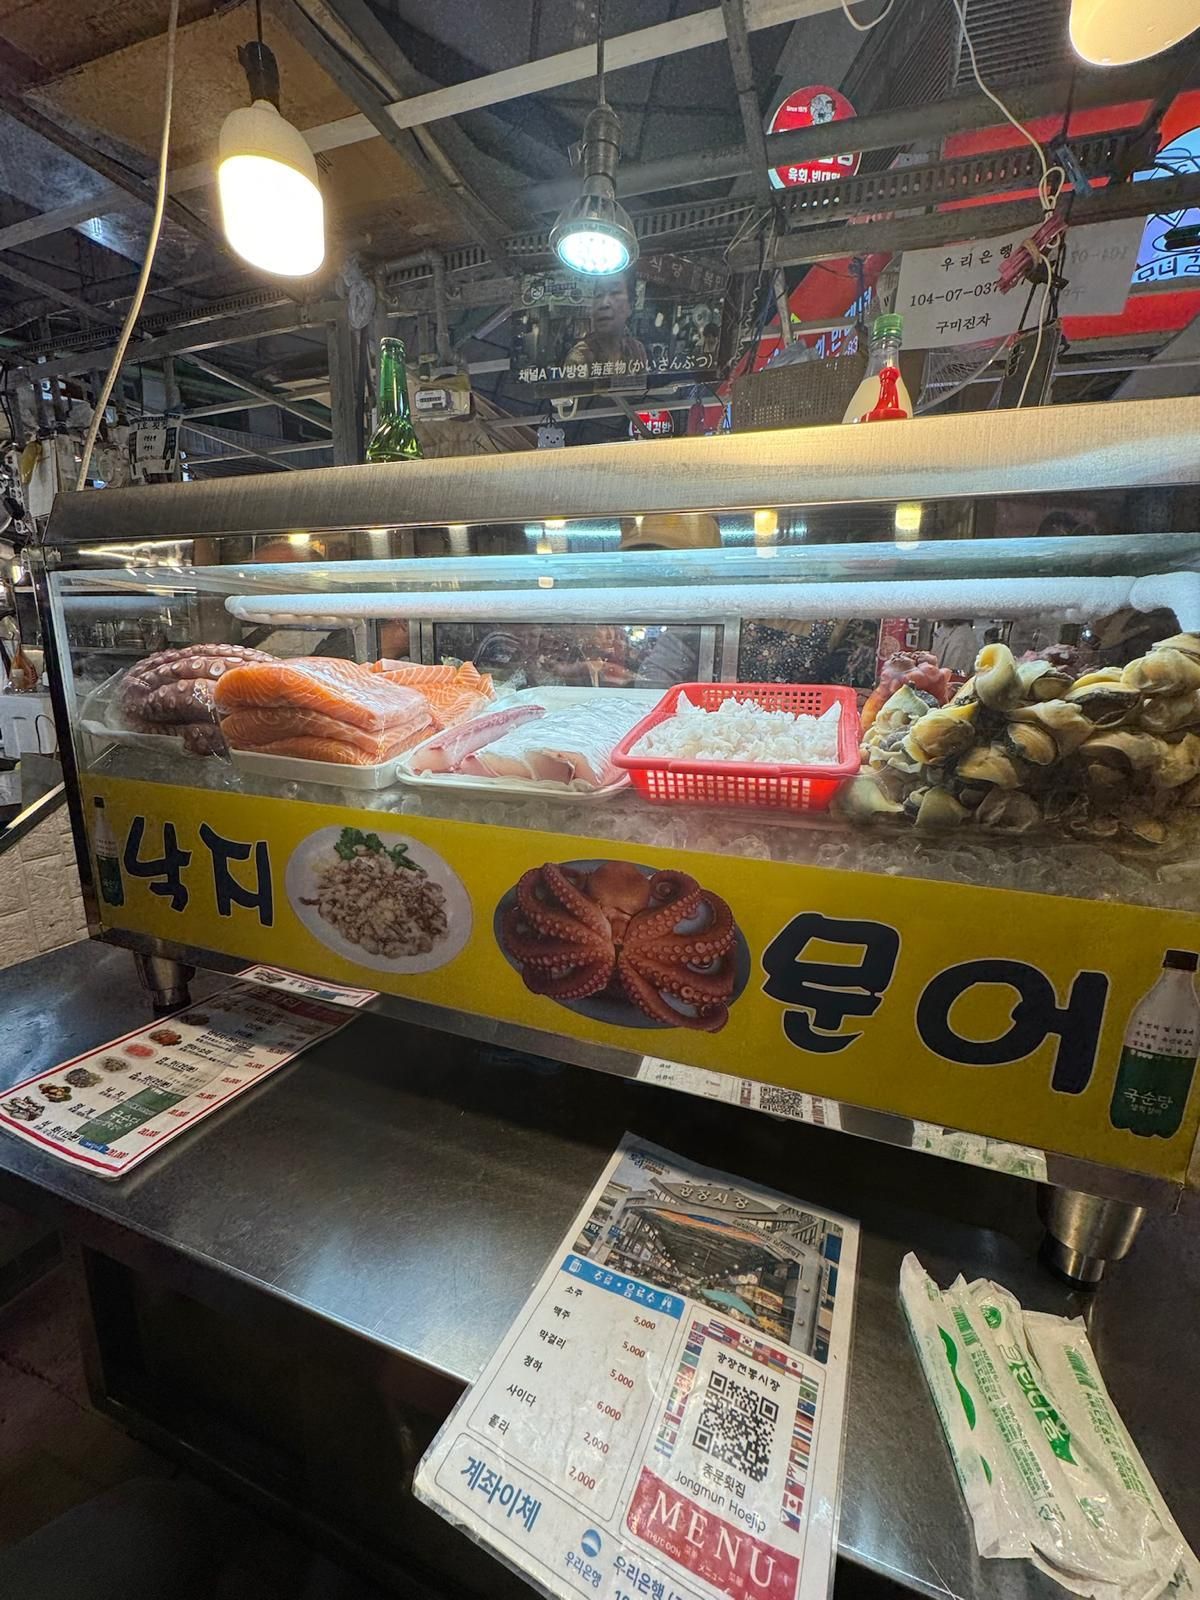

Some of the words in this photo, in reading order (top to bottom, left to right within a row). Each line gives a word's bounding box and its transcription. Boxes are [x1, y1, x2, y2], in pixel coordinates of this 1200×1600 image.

[935, 312, 992, 333] 구미진자
[550, 363, 589, 380] TV방영
[123, 815, 275, 928] 낙지
[760, 911, 1111, 1096] 문어
[1123, 1088, 1174, 1110] 국순당
[679, 1184, 749, 1210] 광장시장
[565, 1285, 584, 1298] 소주
[633, 1315, 656, 1331] 5,000
[593, 1270, 614, 1286] 주류
[623, 1282, 656, 1304] 음료수
[553, 1305, 571, 1320] 맥주
[622, 1341, 646, 1359] 5,000
[538, 1328, 567, 1350] 막걸리
[609, 1368, 635, 1389] 5,000
[716, 1351, 782, 1392] 광장전통시장
[523, 1355, 543, 1372] 청하
[596, 1400, 622, 1421] 6,000
[506, 1383, 537, 1408] 사이다
[583, 1432, 610, 1454] 2,000
[461, 1455, 543, 1533] 계좌이체
[568, 1466, 597, 1490] 2,000
[702, 1463, 747, 1499] 종문횟집
[674, 1470, 725, 1508] Jongmun
[728, 1499, 767, 1533] Hoejip
[650, 1490, 777, 1588] MENU
[564, 1551, 603, 1589] 우리은행
